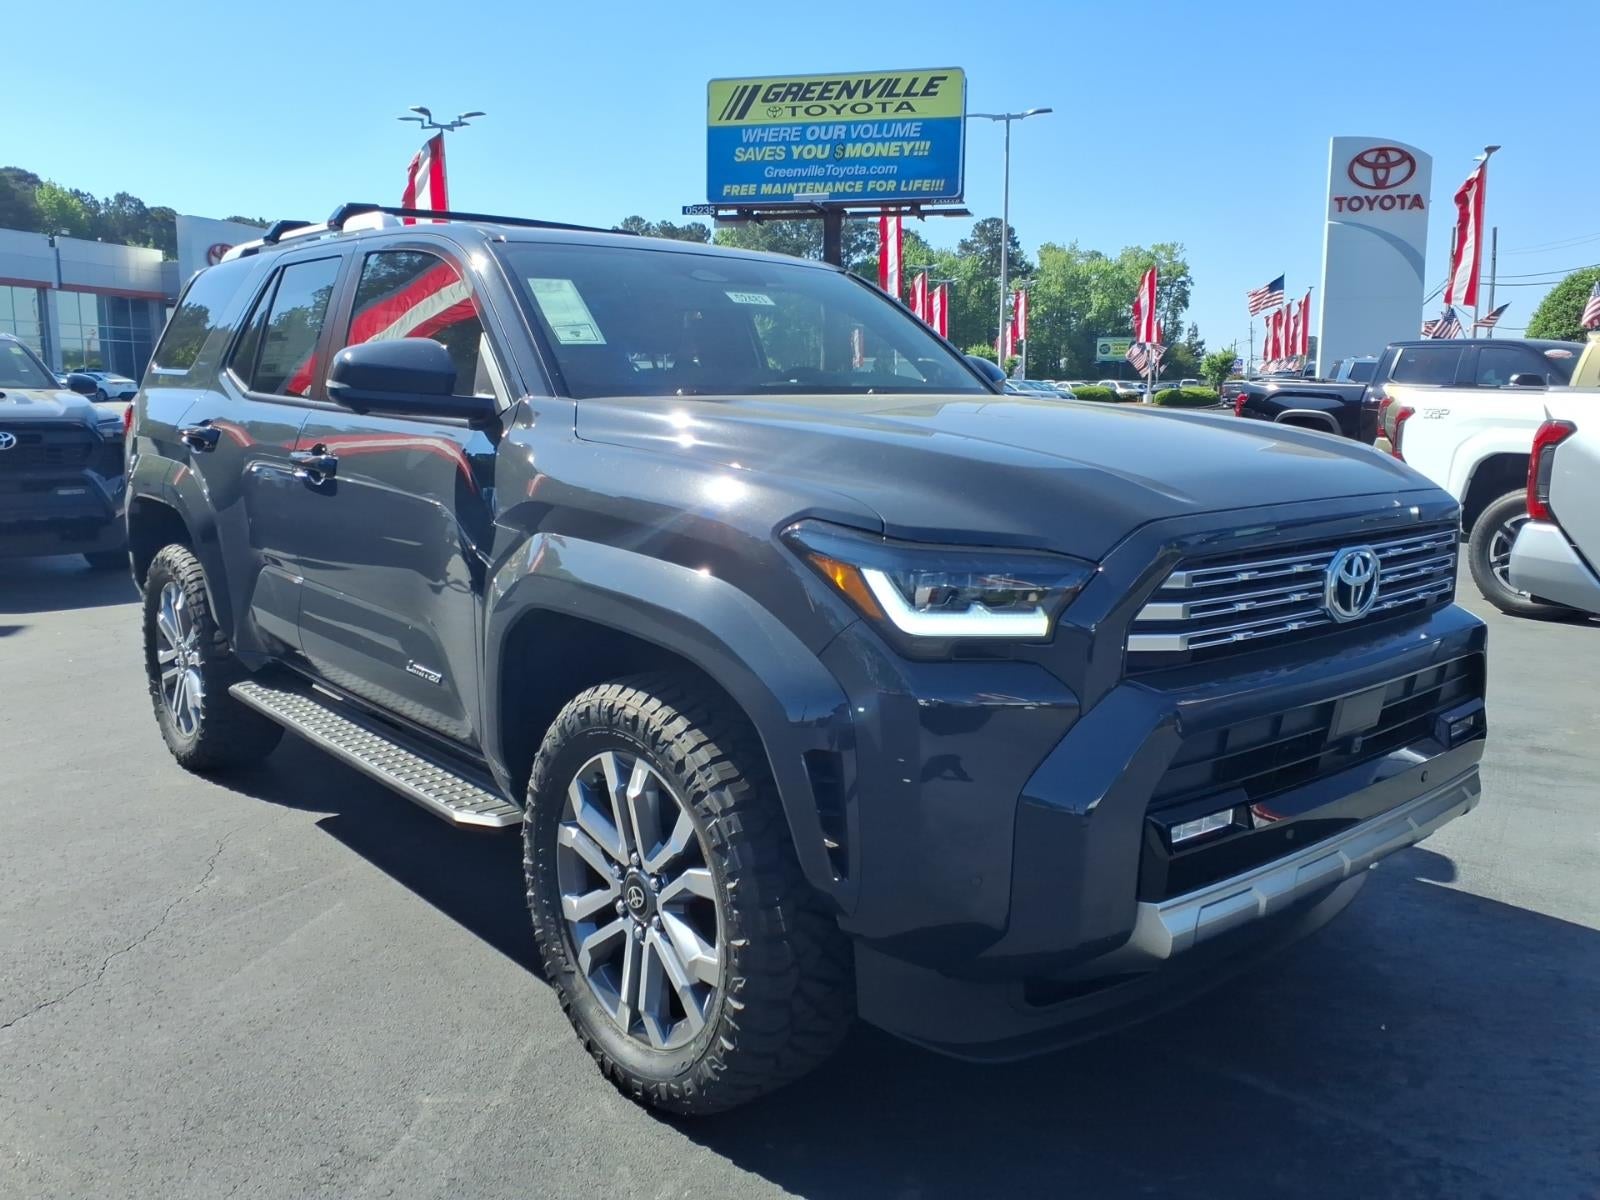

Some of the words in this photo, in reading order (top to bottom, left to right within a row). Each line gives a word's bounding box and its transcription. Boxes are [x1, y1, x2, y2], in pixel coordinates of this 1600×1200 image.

[761, 75, 948, 103] GREENVILLE
[785, 101, 916, 117] TOYOTA
[742, 127, 802, 143] WHERE
[806, 125, 847, 140] OUR
[851, 122, 923, 139] VOLUME
[734, 145, 786, 162] SAVES
[791, 143, 831, 160] YOU
[764, 164, 898, 178] GreenvilleToyota.com
[722, 183, 758, 196] FREE
[760, 180, 864, 195] MAINTENANCE
[867, 179, 897, 193] FOR
[900, 178, 945, 192] LIFE!!!
[685, 205, 716, 215] 05235
[1334, 193, 1425, 213] TOYOTA
